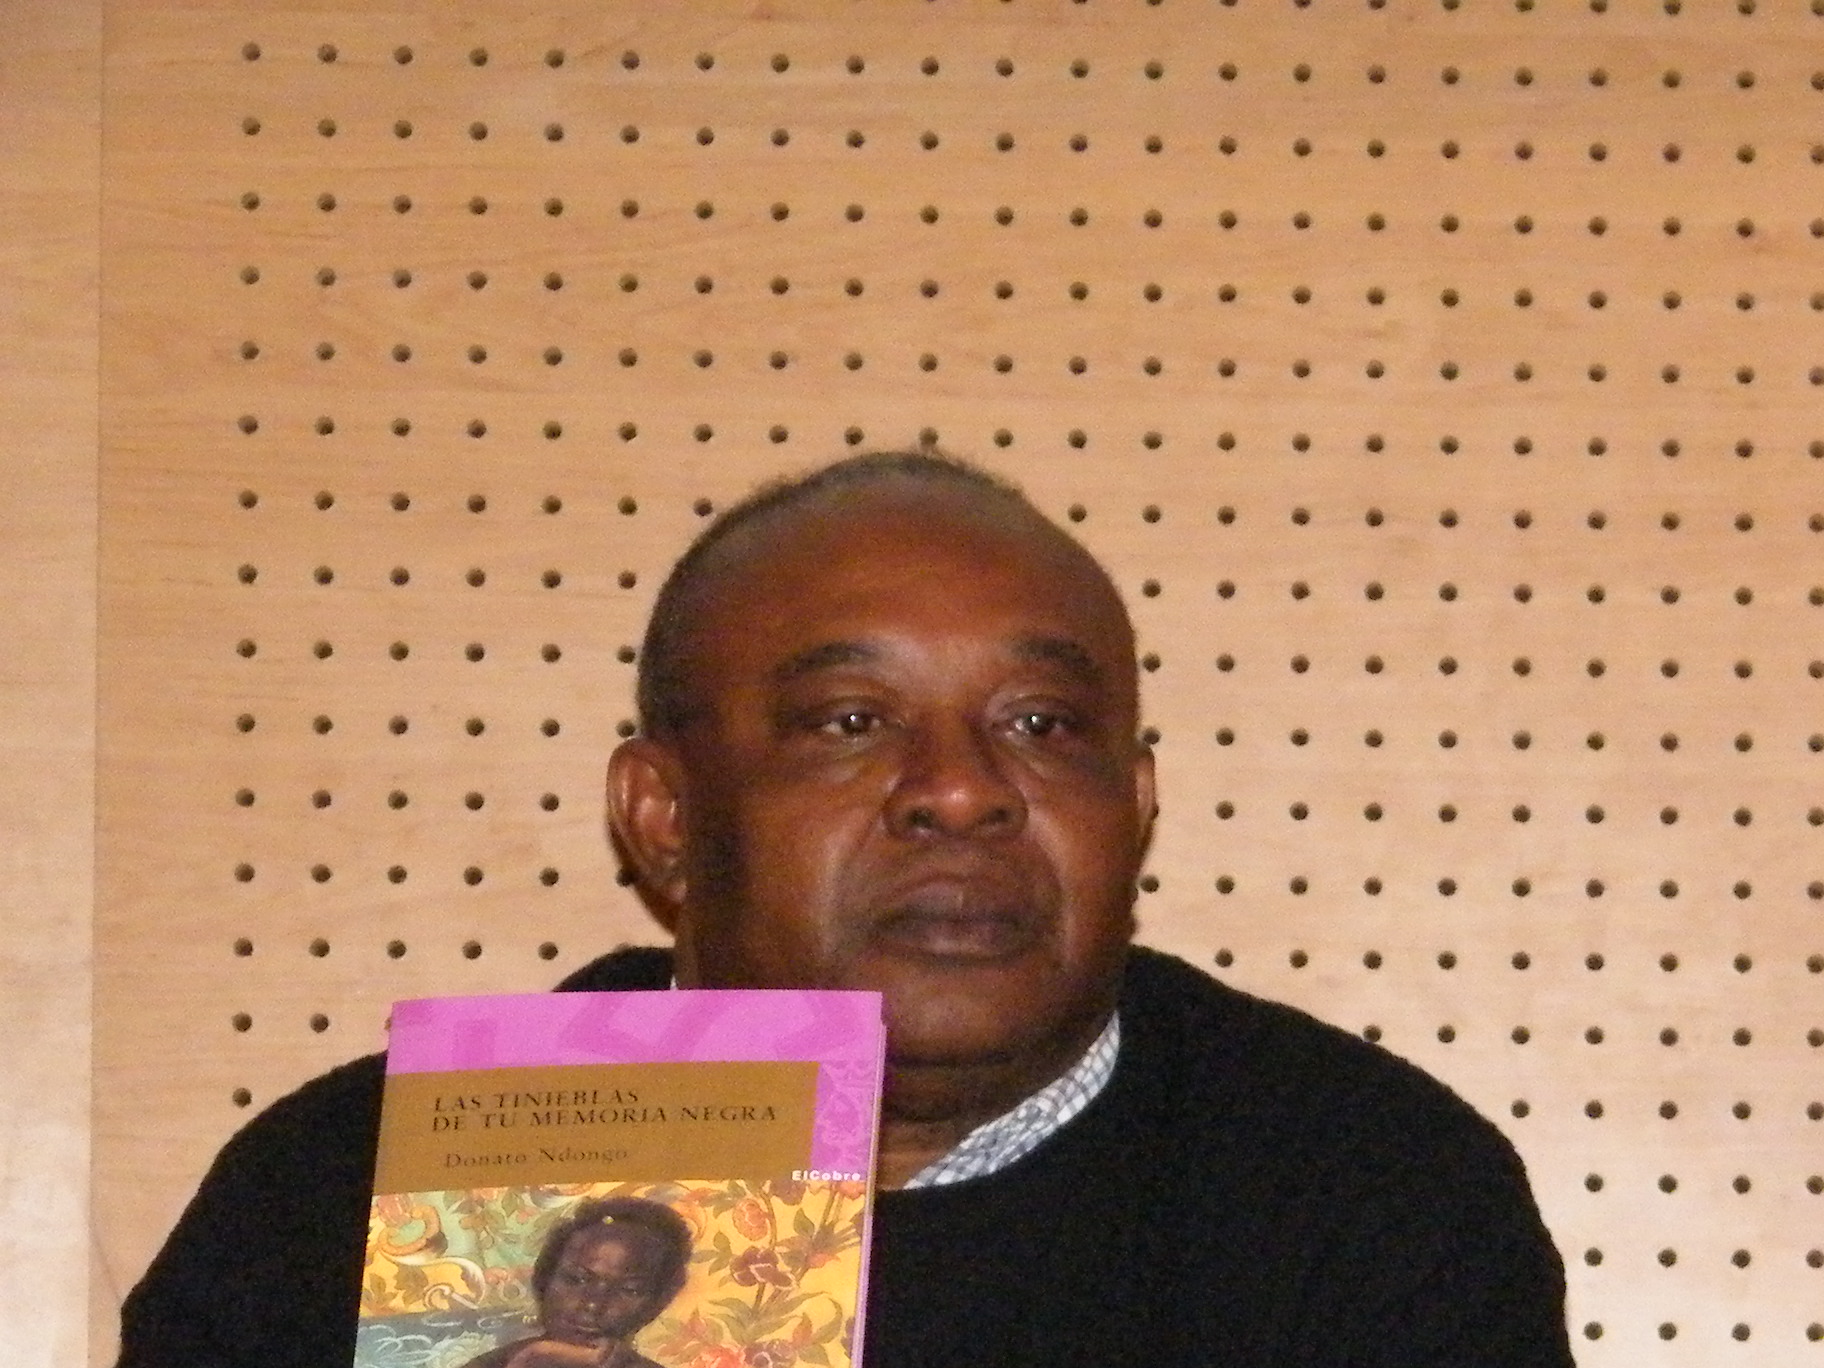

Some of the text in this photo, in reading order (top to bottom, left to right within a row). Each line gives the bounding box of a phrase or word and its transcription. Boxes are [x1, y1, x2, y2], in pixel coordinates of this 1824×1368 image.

[434, 1089, 639, 1113] LAS TINIEBLAS
[432, 1105, 778, 1132] DE TU MEMORIA NEGRA
[445, 1147, 628, 1169] Donato Ndongo
[792, 1170, 861, 1182] ElCobre
